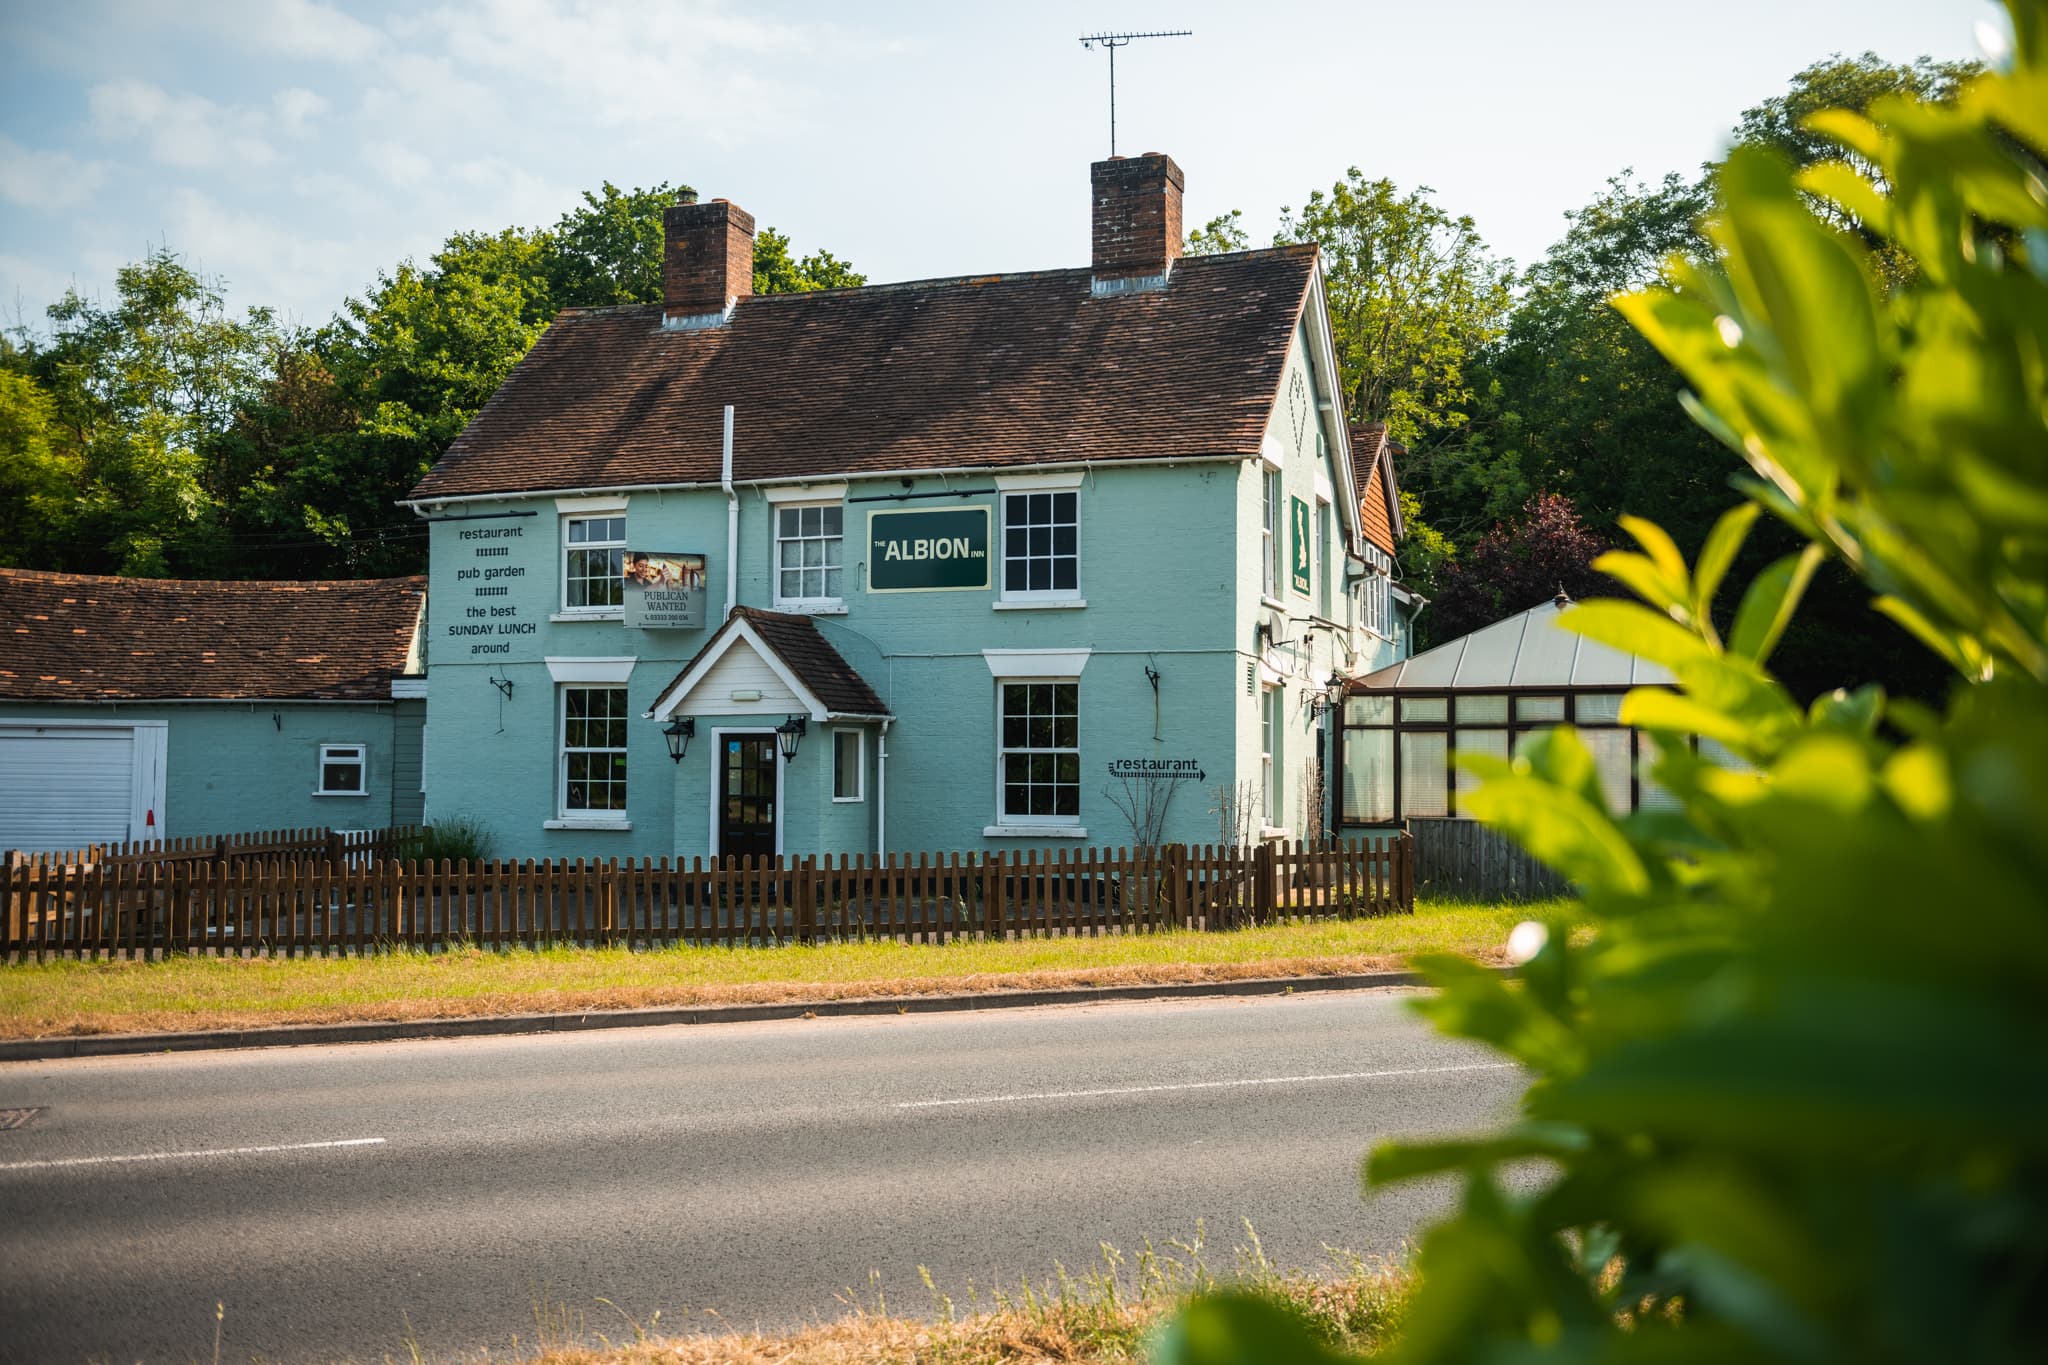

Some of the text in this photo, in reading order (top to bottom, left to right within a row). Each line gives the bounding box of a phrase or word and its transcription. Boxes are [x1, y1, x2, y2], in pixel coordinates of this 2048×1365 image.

[460, 527, 523, 540] restaurant
[884, 537, 969, 560] ALBION
[457, 566, 525, 581] pub garden
[644, 591, 689, 600] PUBLICAN
[466, 605, 517, 617] the best
[647, 602, 687, 611] WANTED
[448, 623, 536, 636] SUNDAY LUNCH
[471, 642, 510, 654] around
[1116, 758, 1198, 770] restaurant
